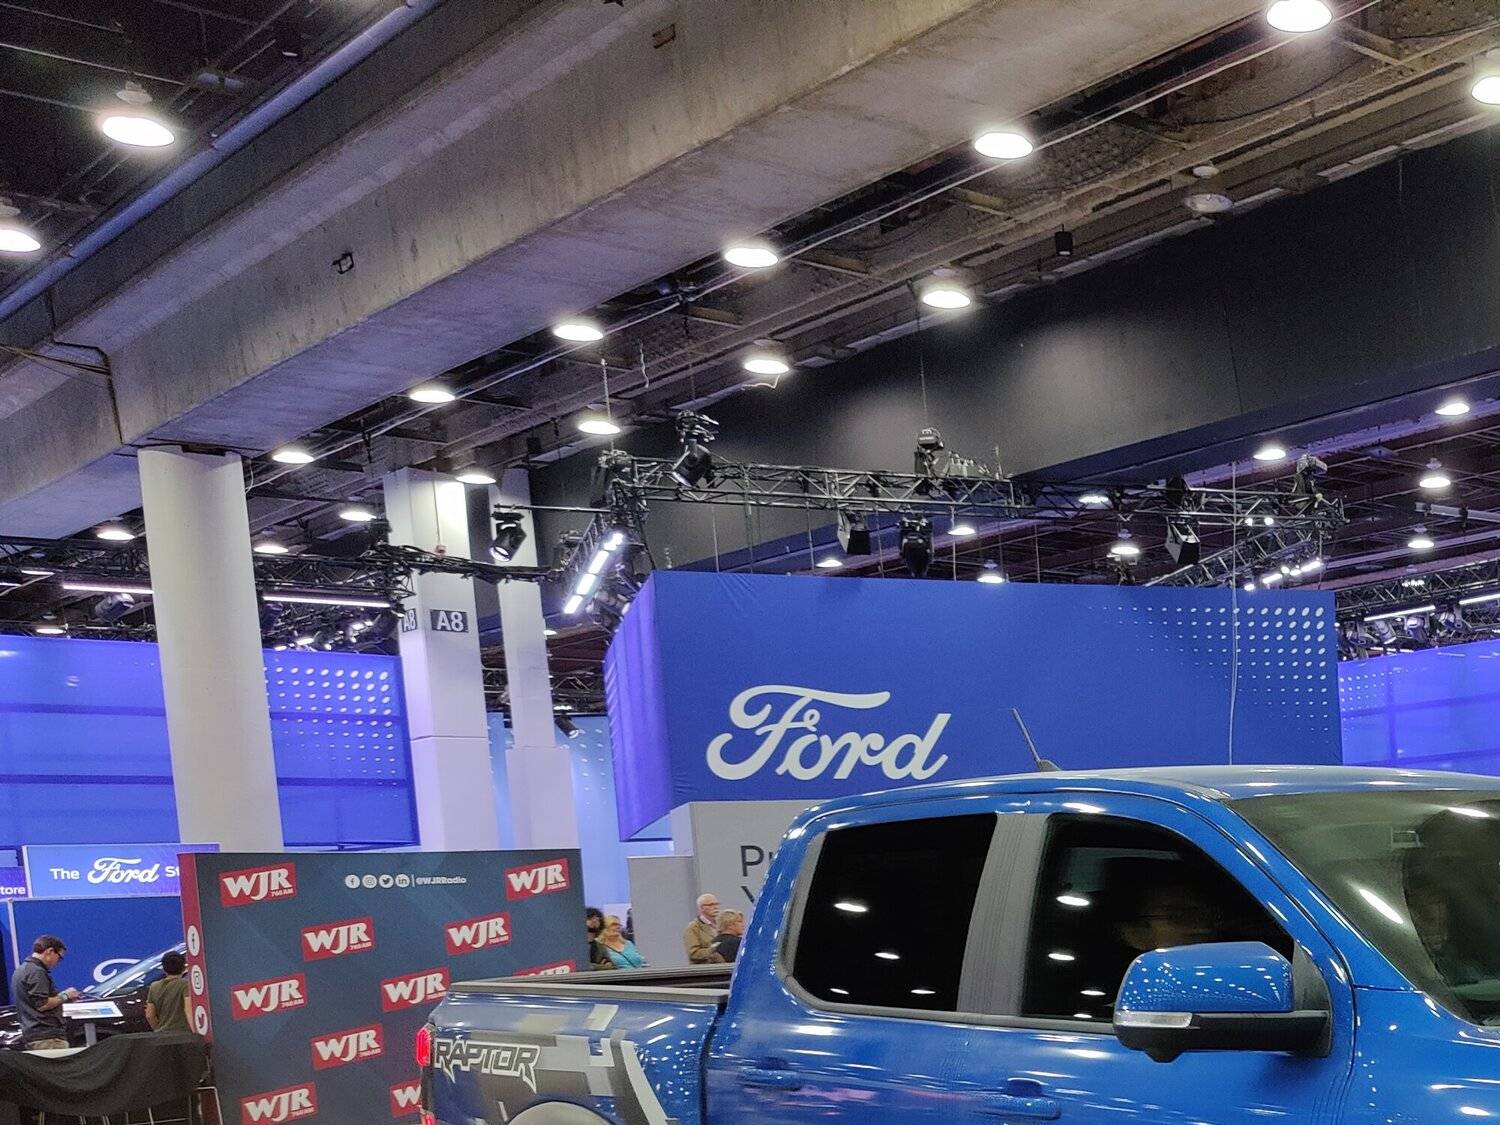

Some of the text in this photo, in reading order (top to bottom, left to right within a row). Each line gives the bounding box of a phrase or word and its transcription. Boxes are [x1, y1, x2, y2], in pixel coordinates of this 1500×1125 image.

[437, 611, 464, 631] A8
[706, 684, 952, 780] Ford
[50, 868, 80, 880] The
[87, 857, 160, 884] Ford
[223, 868, 292, 900] WJR
[416, 876, 467, 885] @WJRRadio
[507, 864, 565, 894] WJR
[0, 886, 26, 896] tore
[304, 922, 370, 954] WJR
[447, 917, 508, 948] WJR
[234, 979, 302, 1012] WJR
[384, 972, 447, 1004] WJR
[315, 1029, 380, 1062] WJR
[434, 1038, 540, 1094] RAPTOR
[244, 1088, 313, 1122] WJR
